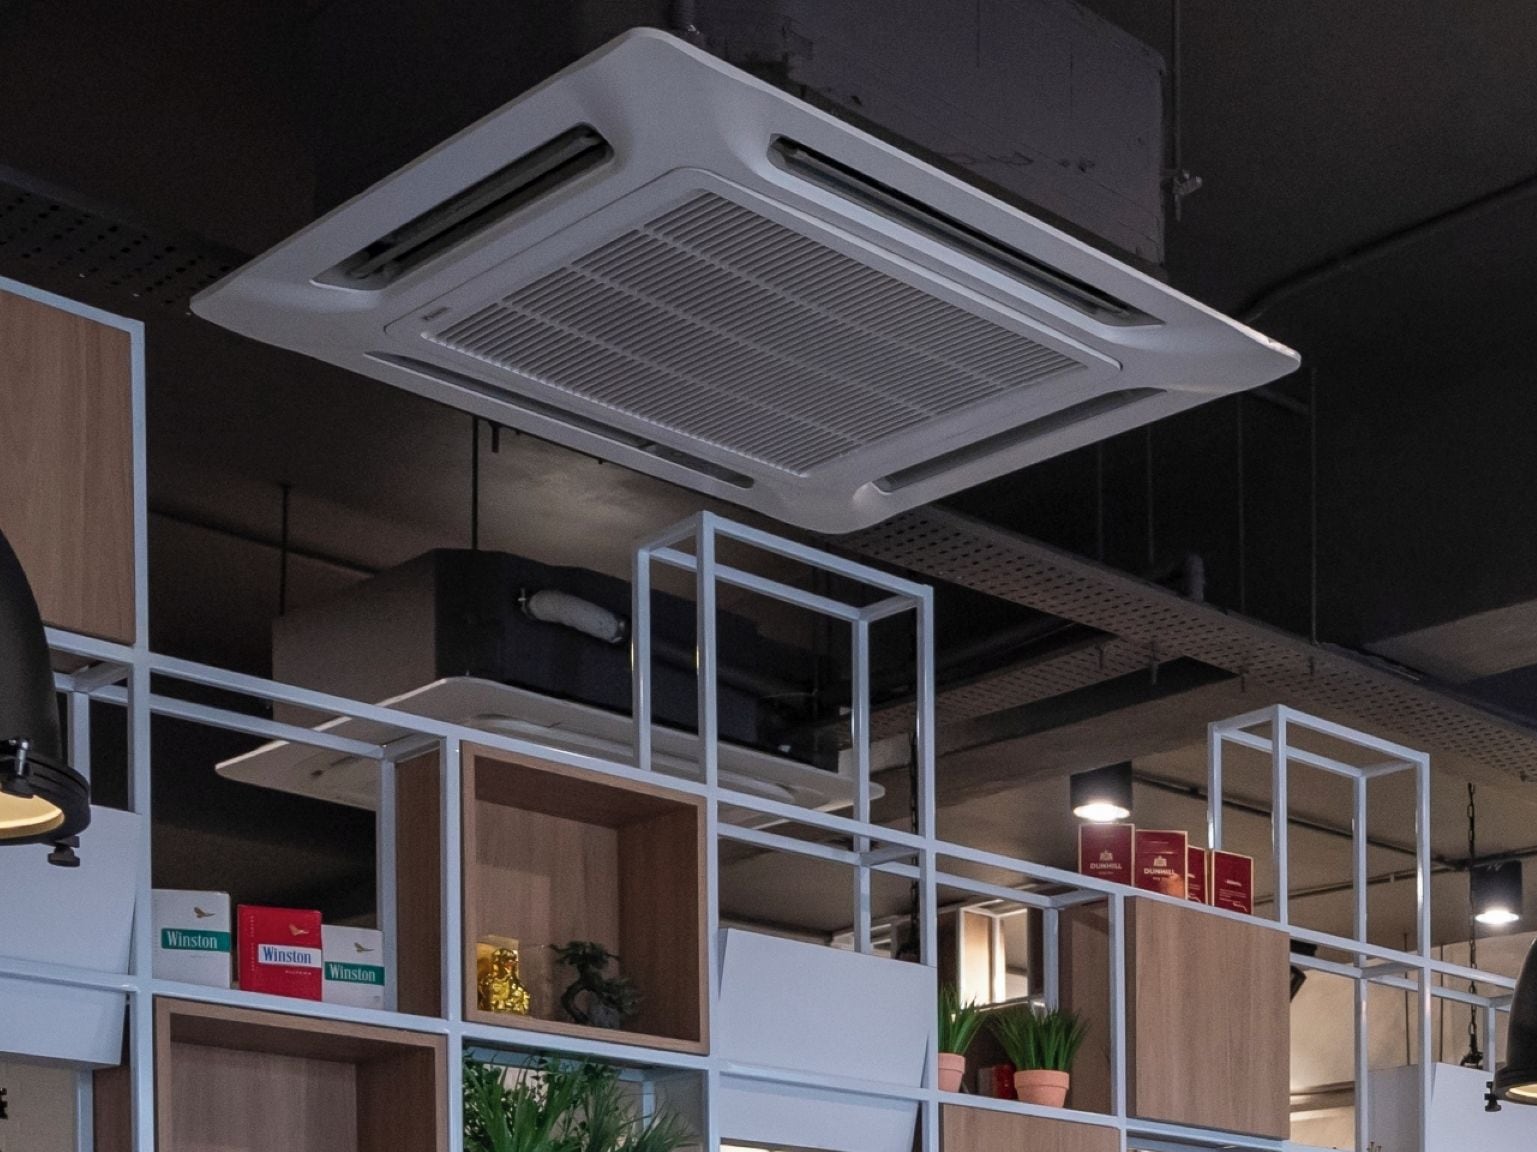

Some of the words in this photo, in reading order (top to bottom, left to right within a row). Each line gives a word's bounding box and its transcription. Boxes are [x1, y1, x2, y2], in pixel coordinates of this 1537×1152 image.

[166, 930, 218, 949] Winston
[263, 946, 312, 964] Winston
[329, 963, 377, 982] Winston
